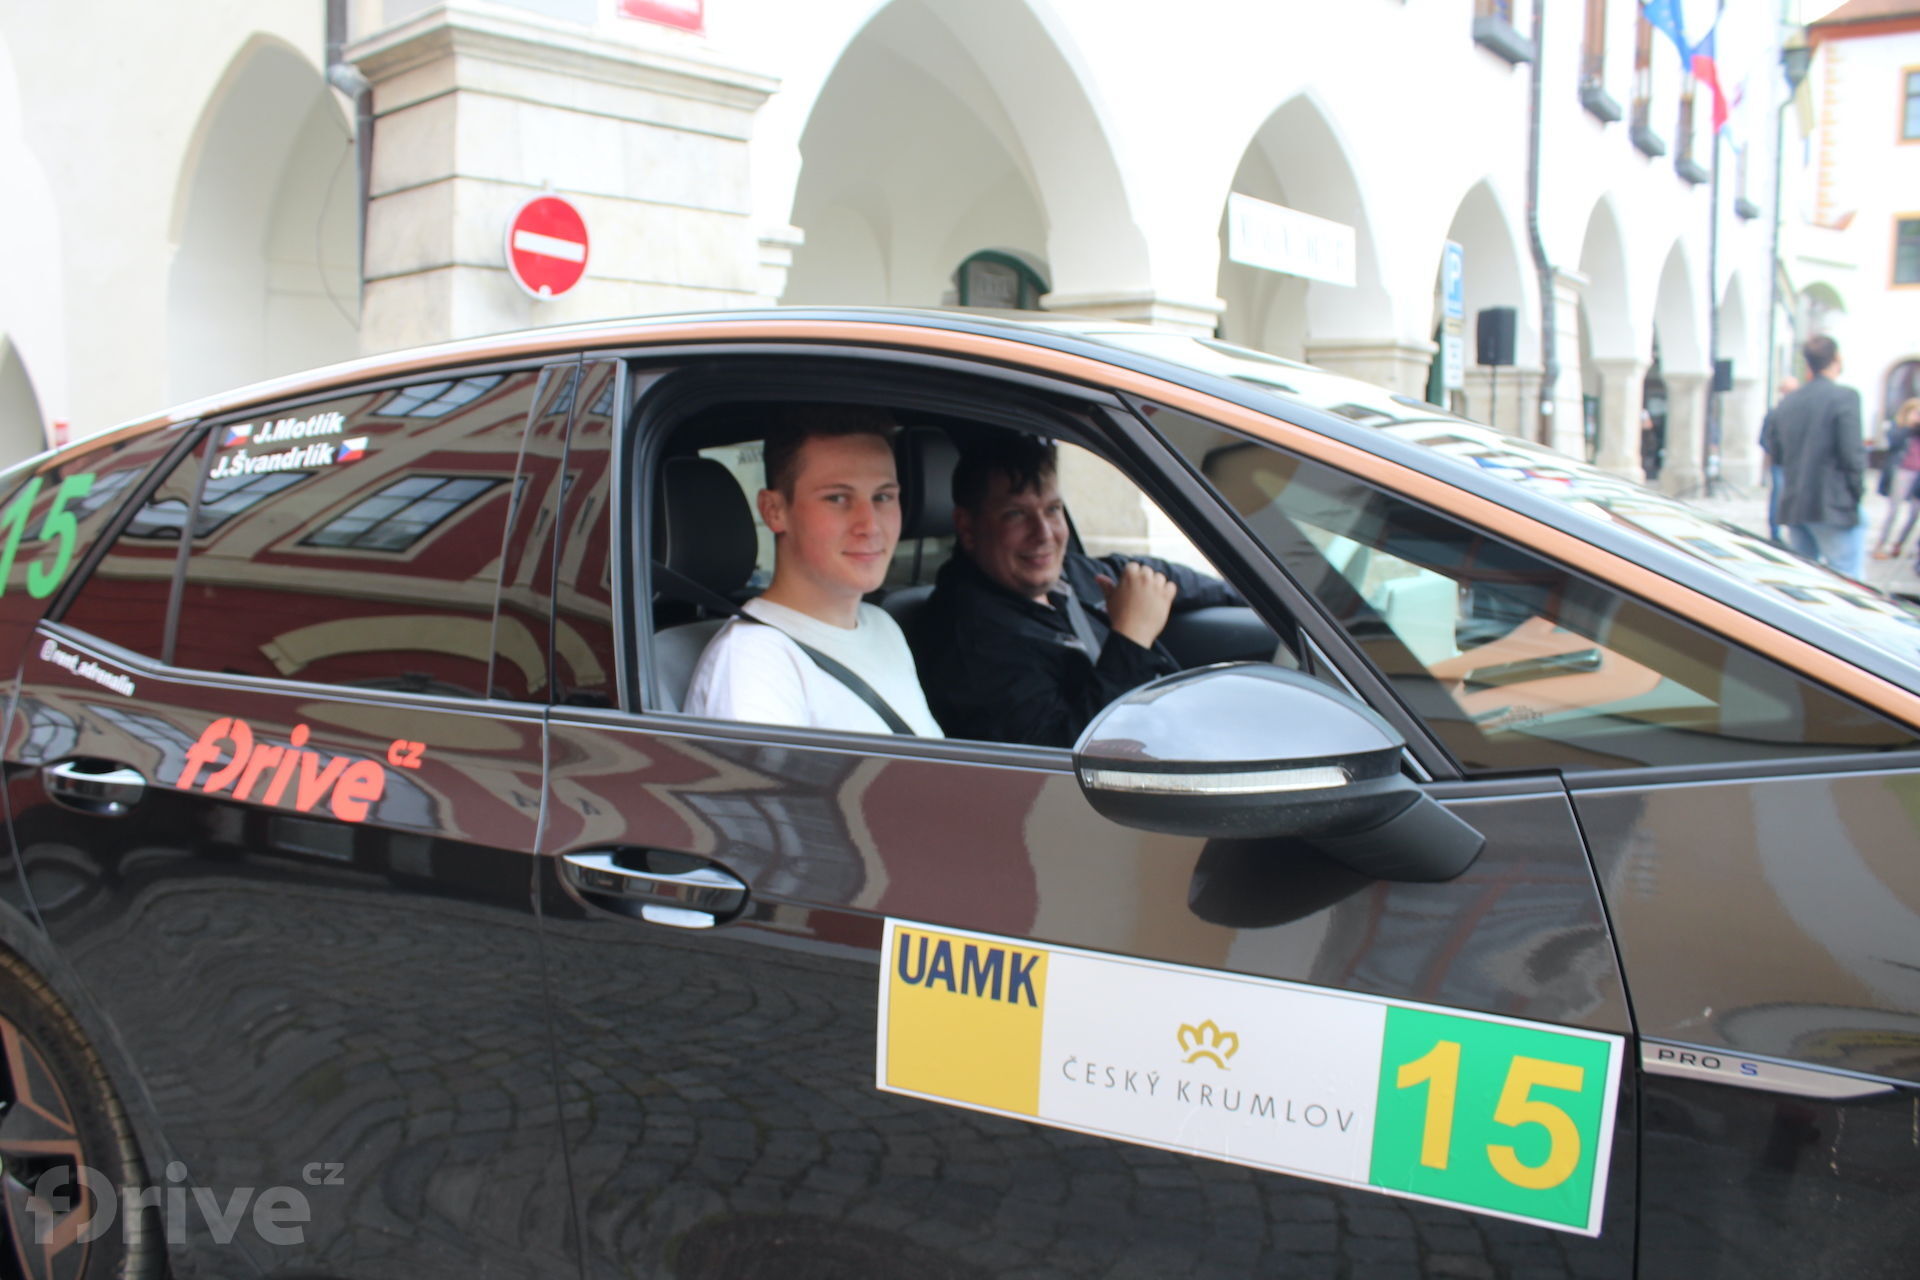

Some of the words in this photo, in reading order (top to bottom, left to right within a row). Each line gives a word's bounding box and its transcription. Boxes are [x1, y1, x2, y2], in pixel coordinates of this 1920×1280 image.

[0, 473, 96, 598] 15
[898, 933, 1041, 1008] UAMK
[1062, 1055, 1160, 1096] ČESKÝ
[1176, 1079, 1354, 1133] KRUMLOV
[1658, 1049, 1721, 1069] PRO
[1739, 1063, 1758, 1076] S
[1396, 1039, 1585, 1190] 15
